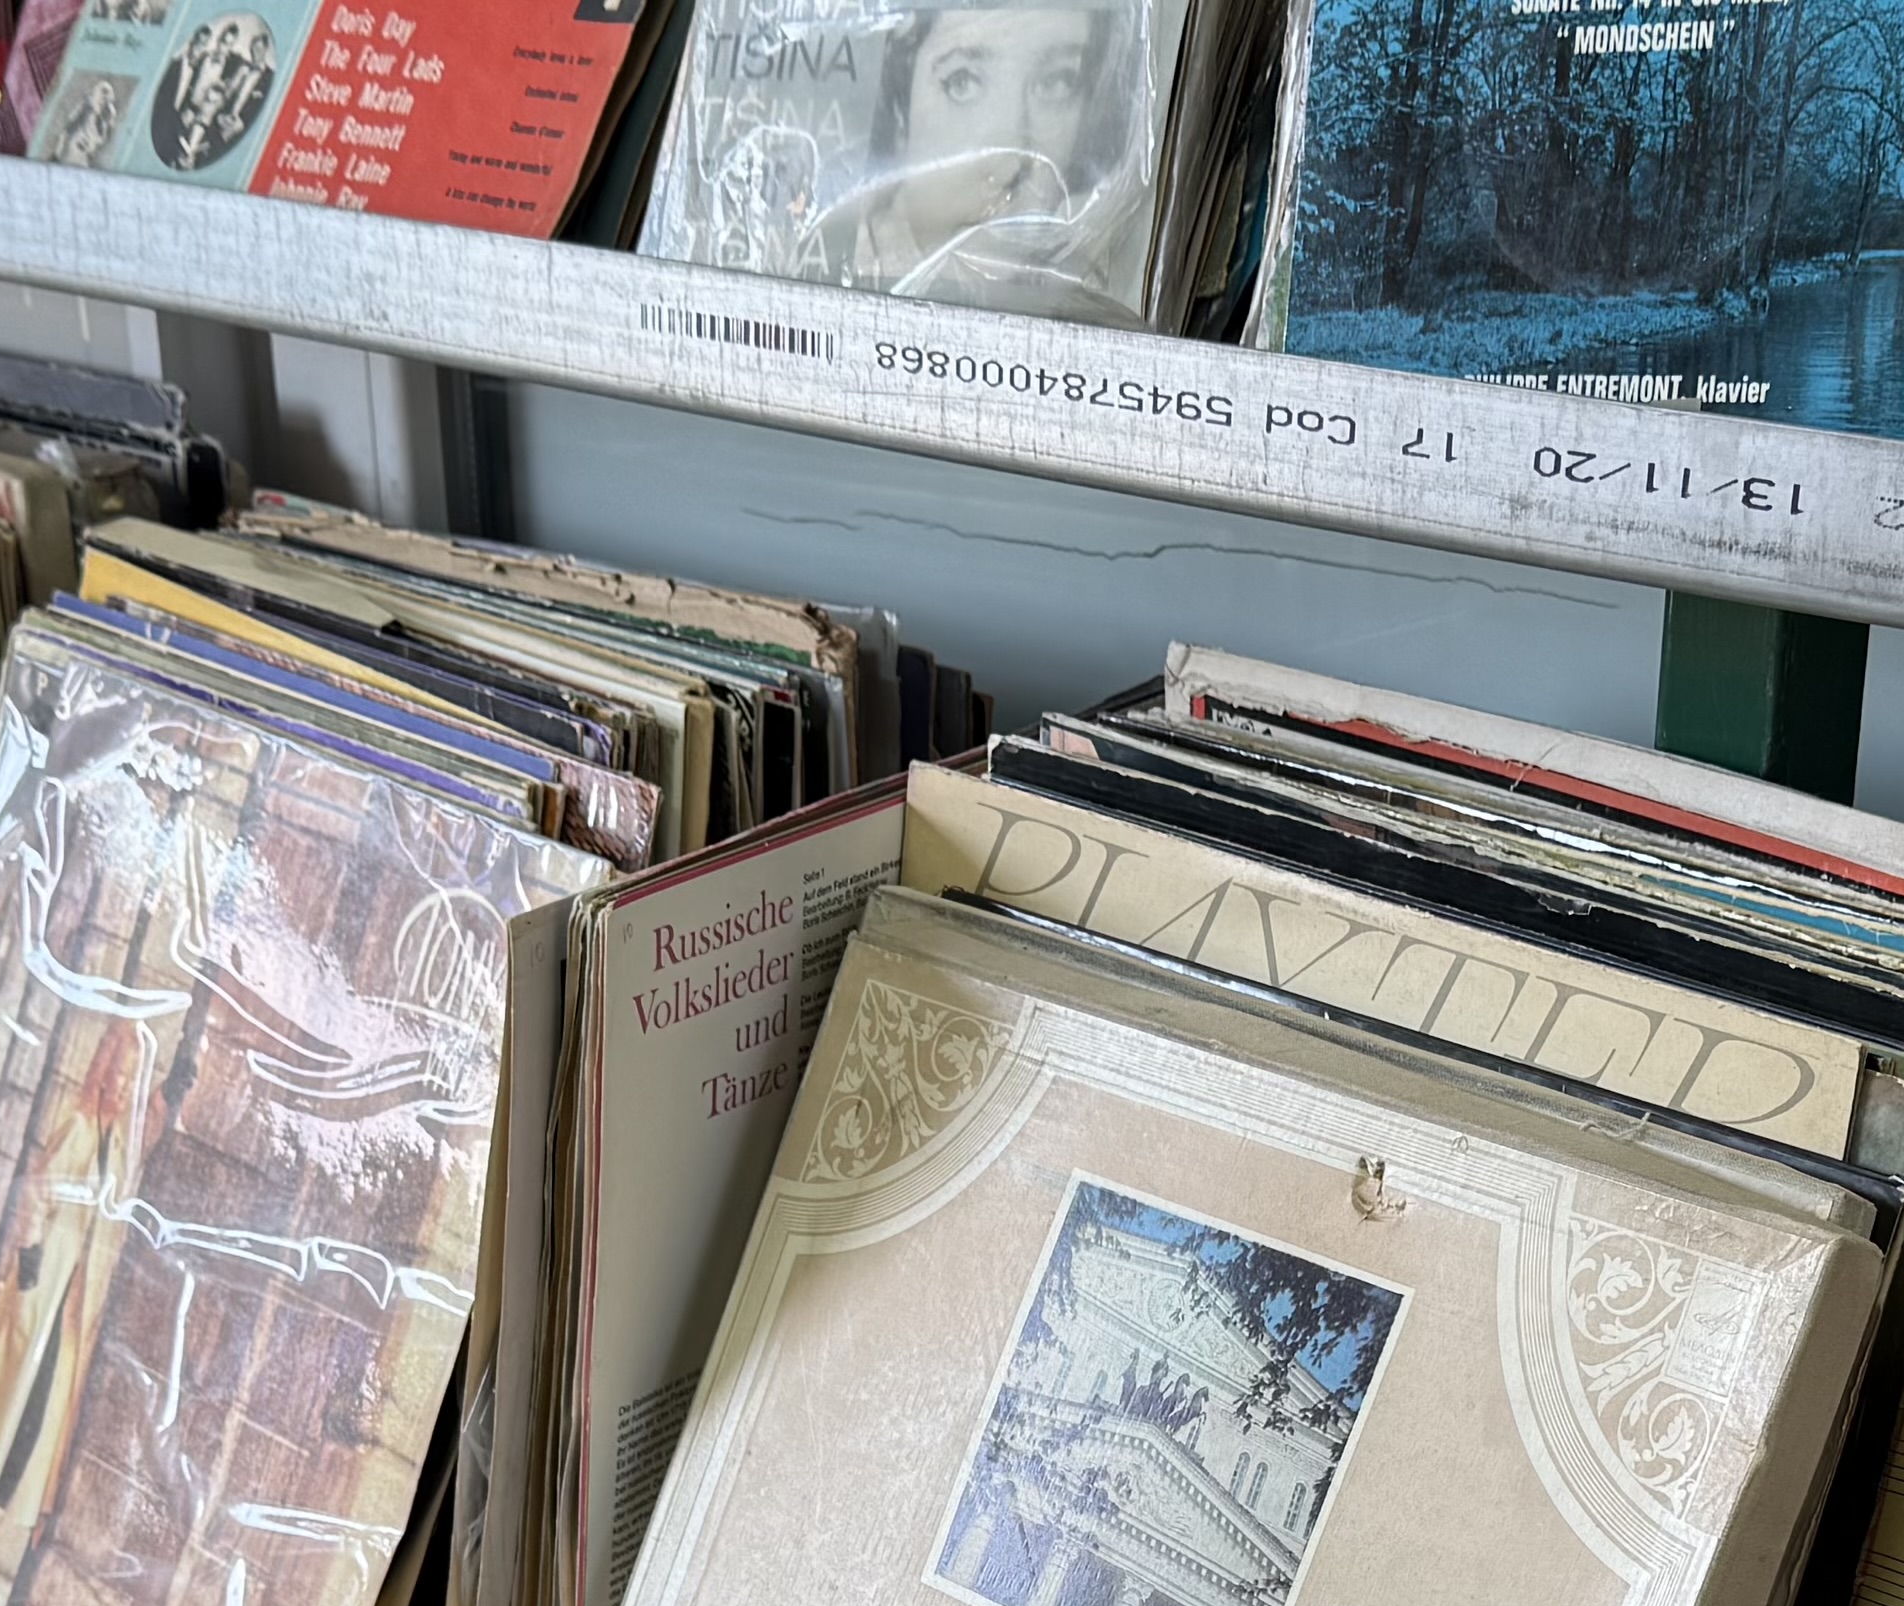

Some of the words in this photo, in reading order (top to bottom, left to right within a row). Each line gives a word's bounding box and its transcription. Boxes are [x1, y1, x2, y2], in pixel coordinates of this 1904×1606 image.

[332, 4, 375, 37] Doris
[382, 12, 417, 48] Day
[319, 39, 350, 72] The
[357, 45, 398, 78] Four
[403, 50, 444, 85] Lads
[304, 73, 352, 107] Steve
[357, 82, 415, 116] Martin
[293, 107, 334, 142] Tony
[338, 114, 408, 152] Bennett
[276, 142, 339, 178] Frankie
[344, 153, 393, 186] Laine
[874, 341, 1234, 430] 5945784000868
[1696, 374, 1771, 404] klavier
[1265, 403, 1357, 447] Cod
[1401, 426, 1458, 464] 17
[1533, 445, 1806, 517] 13/11/20
[651, 889, 796, 974] Russische
[632, 950, 796, 1037] Volkslieder
[735, 993, 789, 1053] und
[700, 1060, 790, 1121] Tänze
